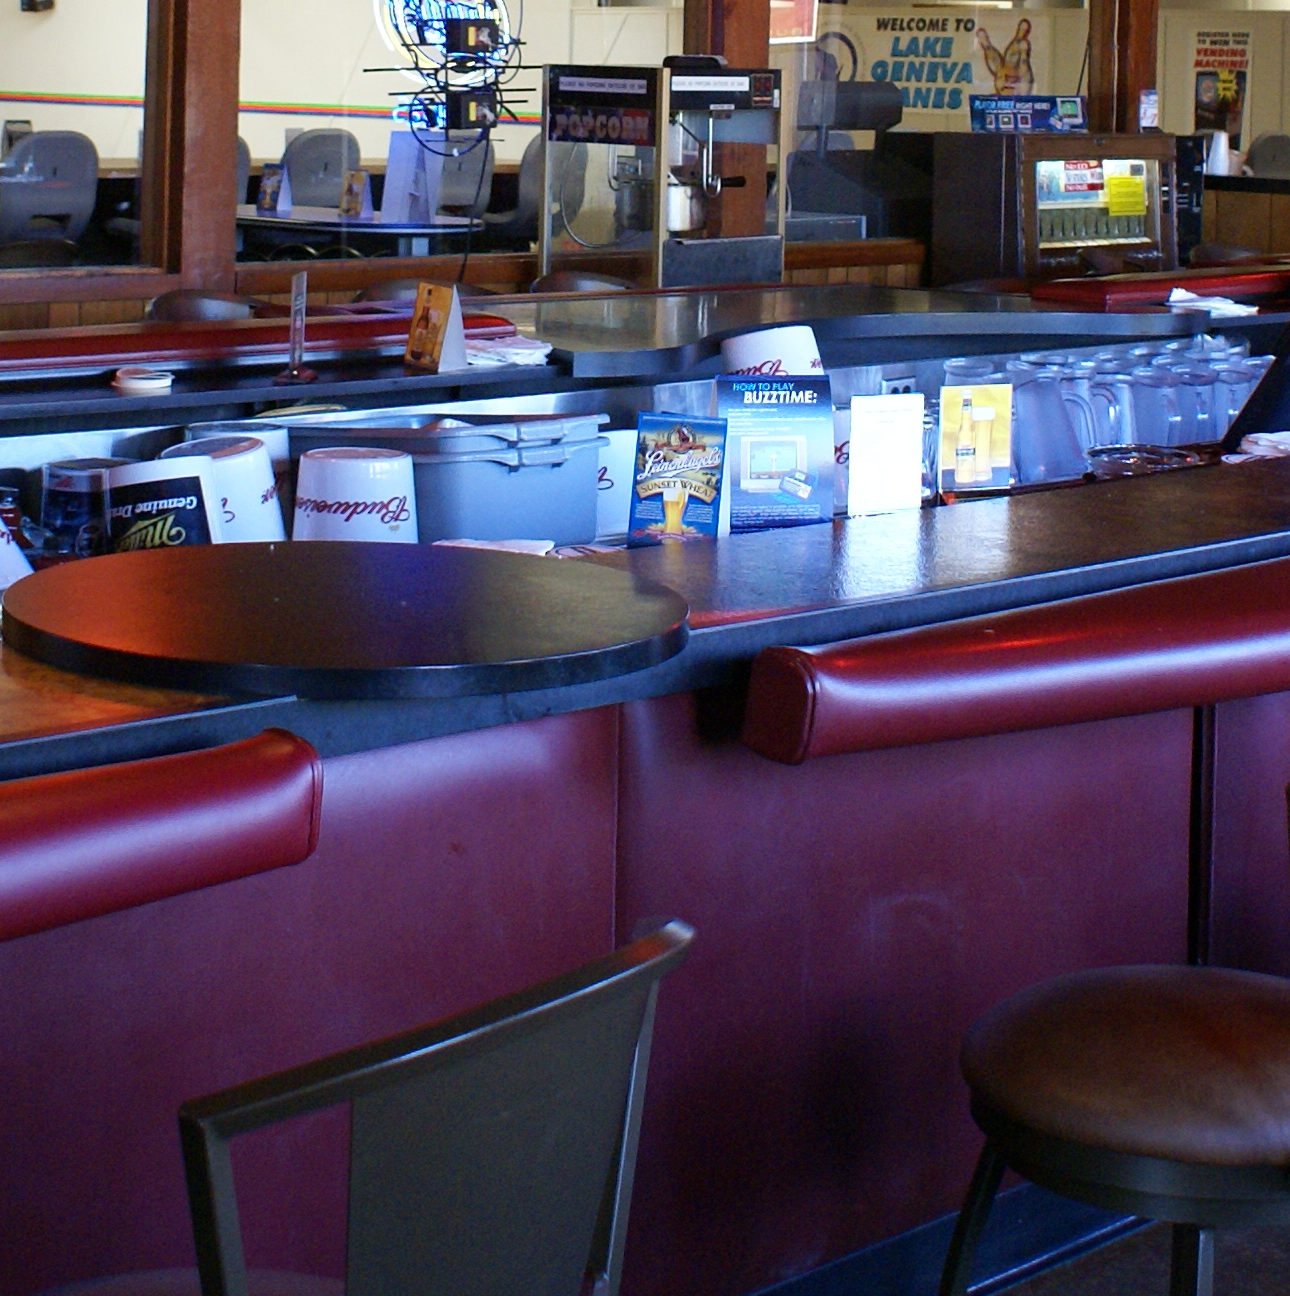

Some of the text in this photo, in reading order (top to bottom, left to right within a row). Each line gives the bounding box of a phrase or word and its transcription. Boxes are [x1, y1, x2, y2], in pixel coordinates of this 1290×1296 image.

[876, 17, 976, 33] WELCOME TO
[890, 36, 955, 59] LAKE
[1195, 48, 1247, 58] VENDING
[871, 59, 974, 84] GENEVA
[1194, 59, 1249, 69] MACHINE!
[900, 86, 963, 110] ANES
[554, 113, 650, 141] POPCORN
[732, 382, 795, 392] HOW TO PLAY
[743, 390, 818, 404] BUZZTIME:
[641, 479, 714, 499] SUNSET WHEAT
[134, 495, 198, 515] Genuine
